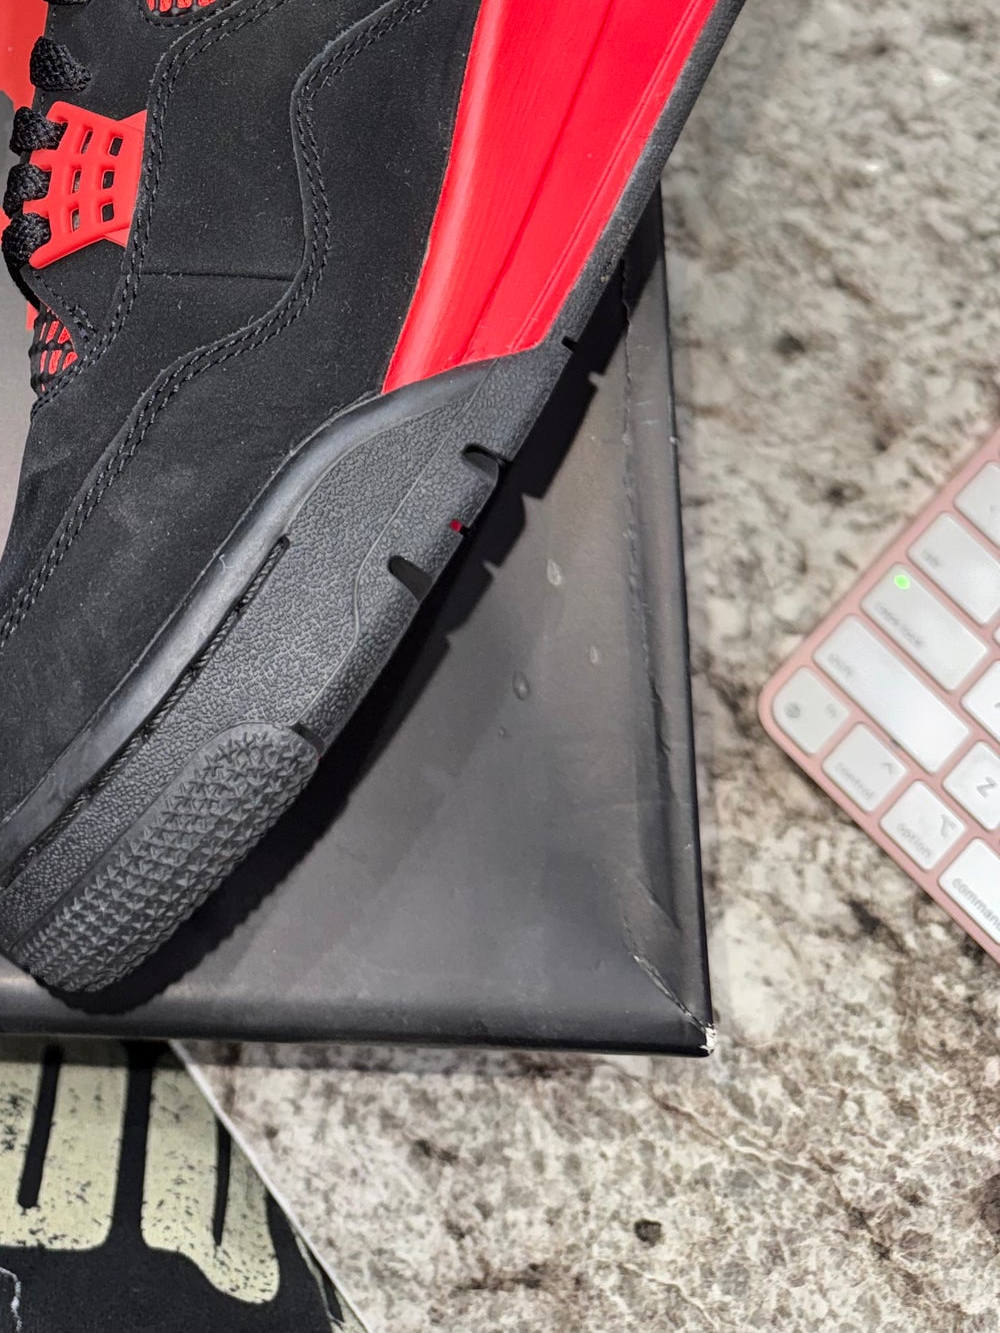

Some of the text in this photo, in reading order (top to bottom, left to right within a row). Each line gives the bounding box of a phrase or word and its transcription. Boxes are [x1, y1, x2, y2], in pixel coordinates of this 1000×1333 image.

[832, 760, 876, 802] control
[973, 774, 999, 799] Z
[894, 820, 935, 859] option
